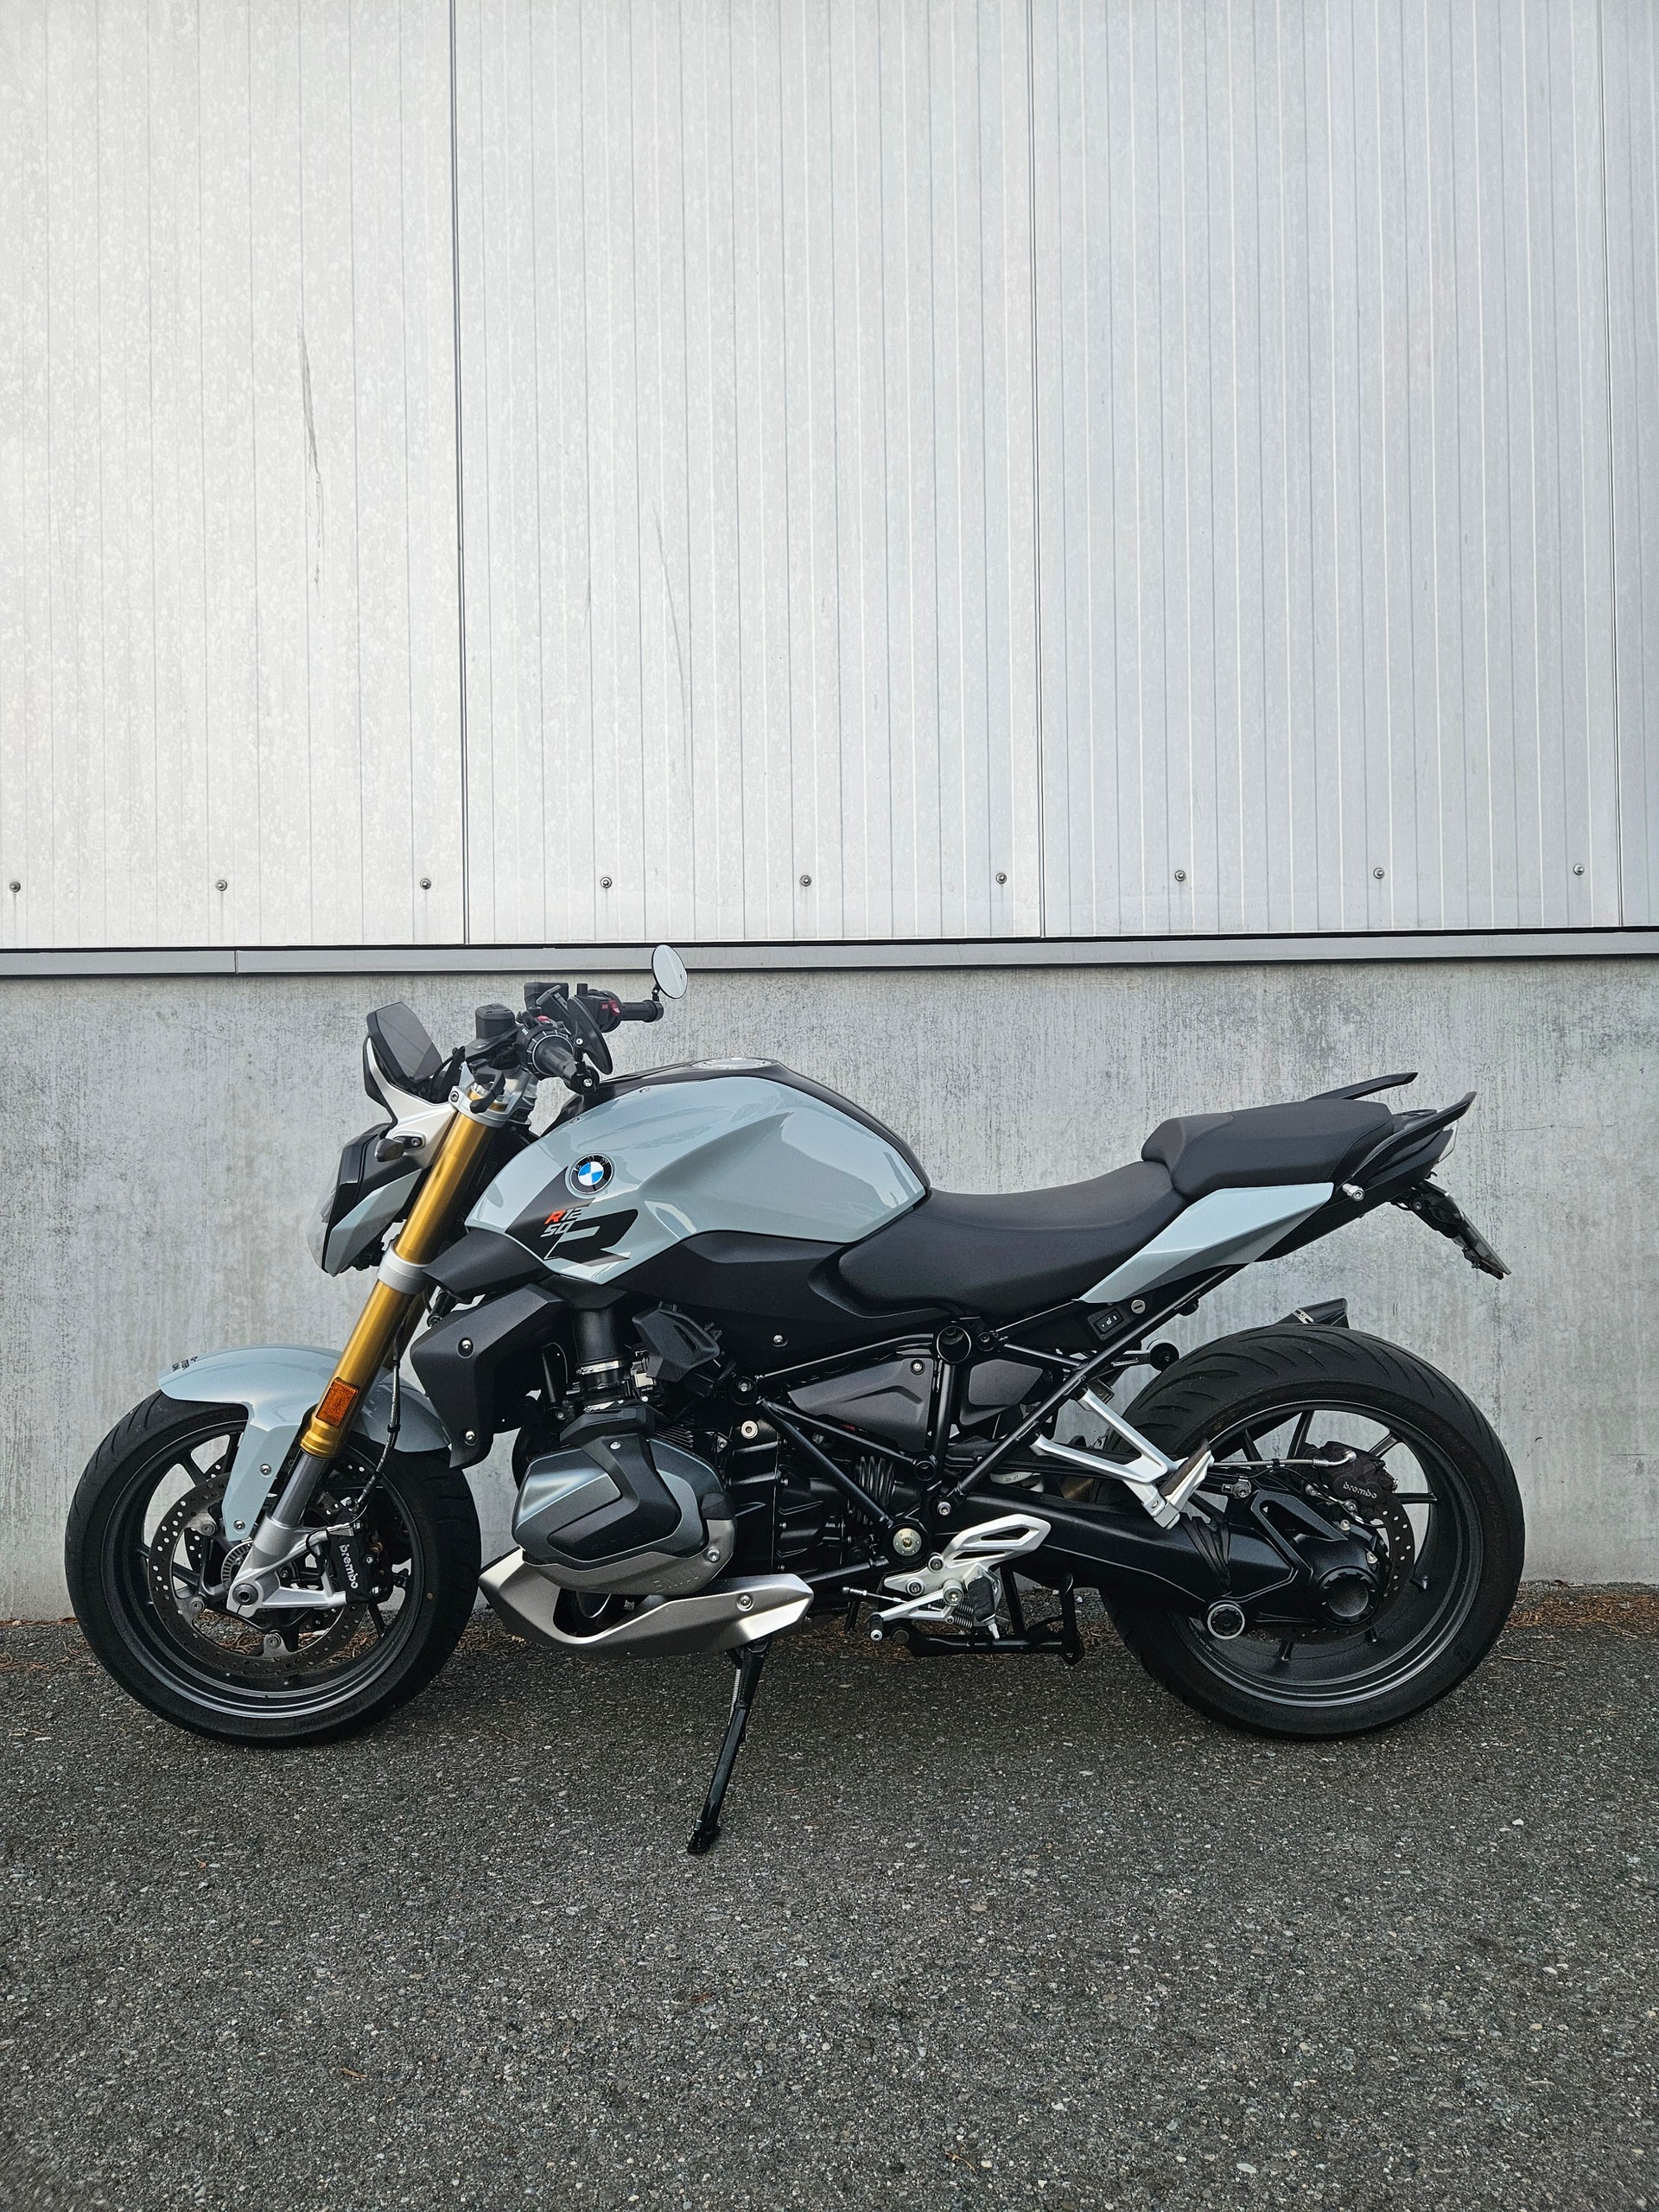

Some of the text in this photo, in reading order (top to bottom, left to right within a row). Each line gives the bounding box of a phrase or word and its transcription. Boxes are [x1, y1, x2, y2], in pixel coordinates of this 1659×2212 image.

[540, 1220, 575, 1238] 50
[1342, 1481, 1377, 1499] brembo
[339, 1543, 359, 1589] brembo
